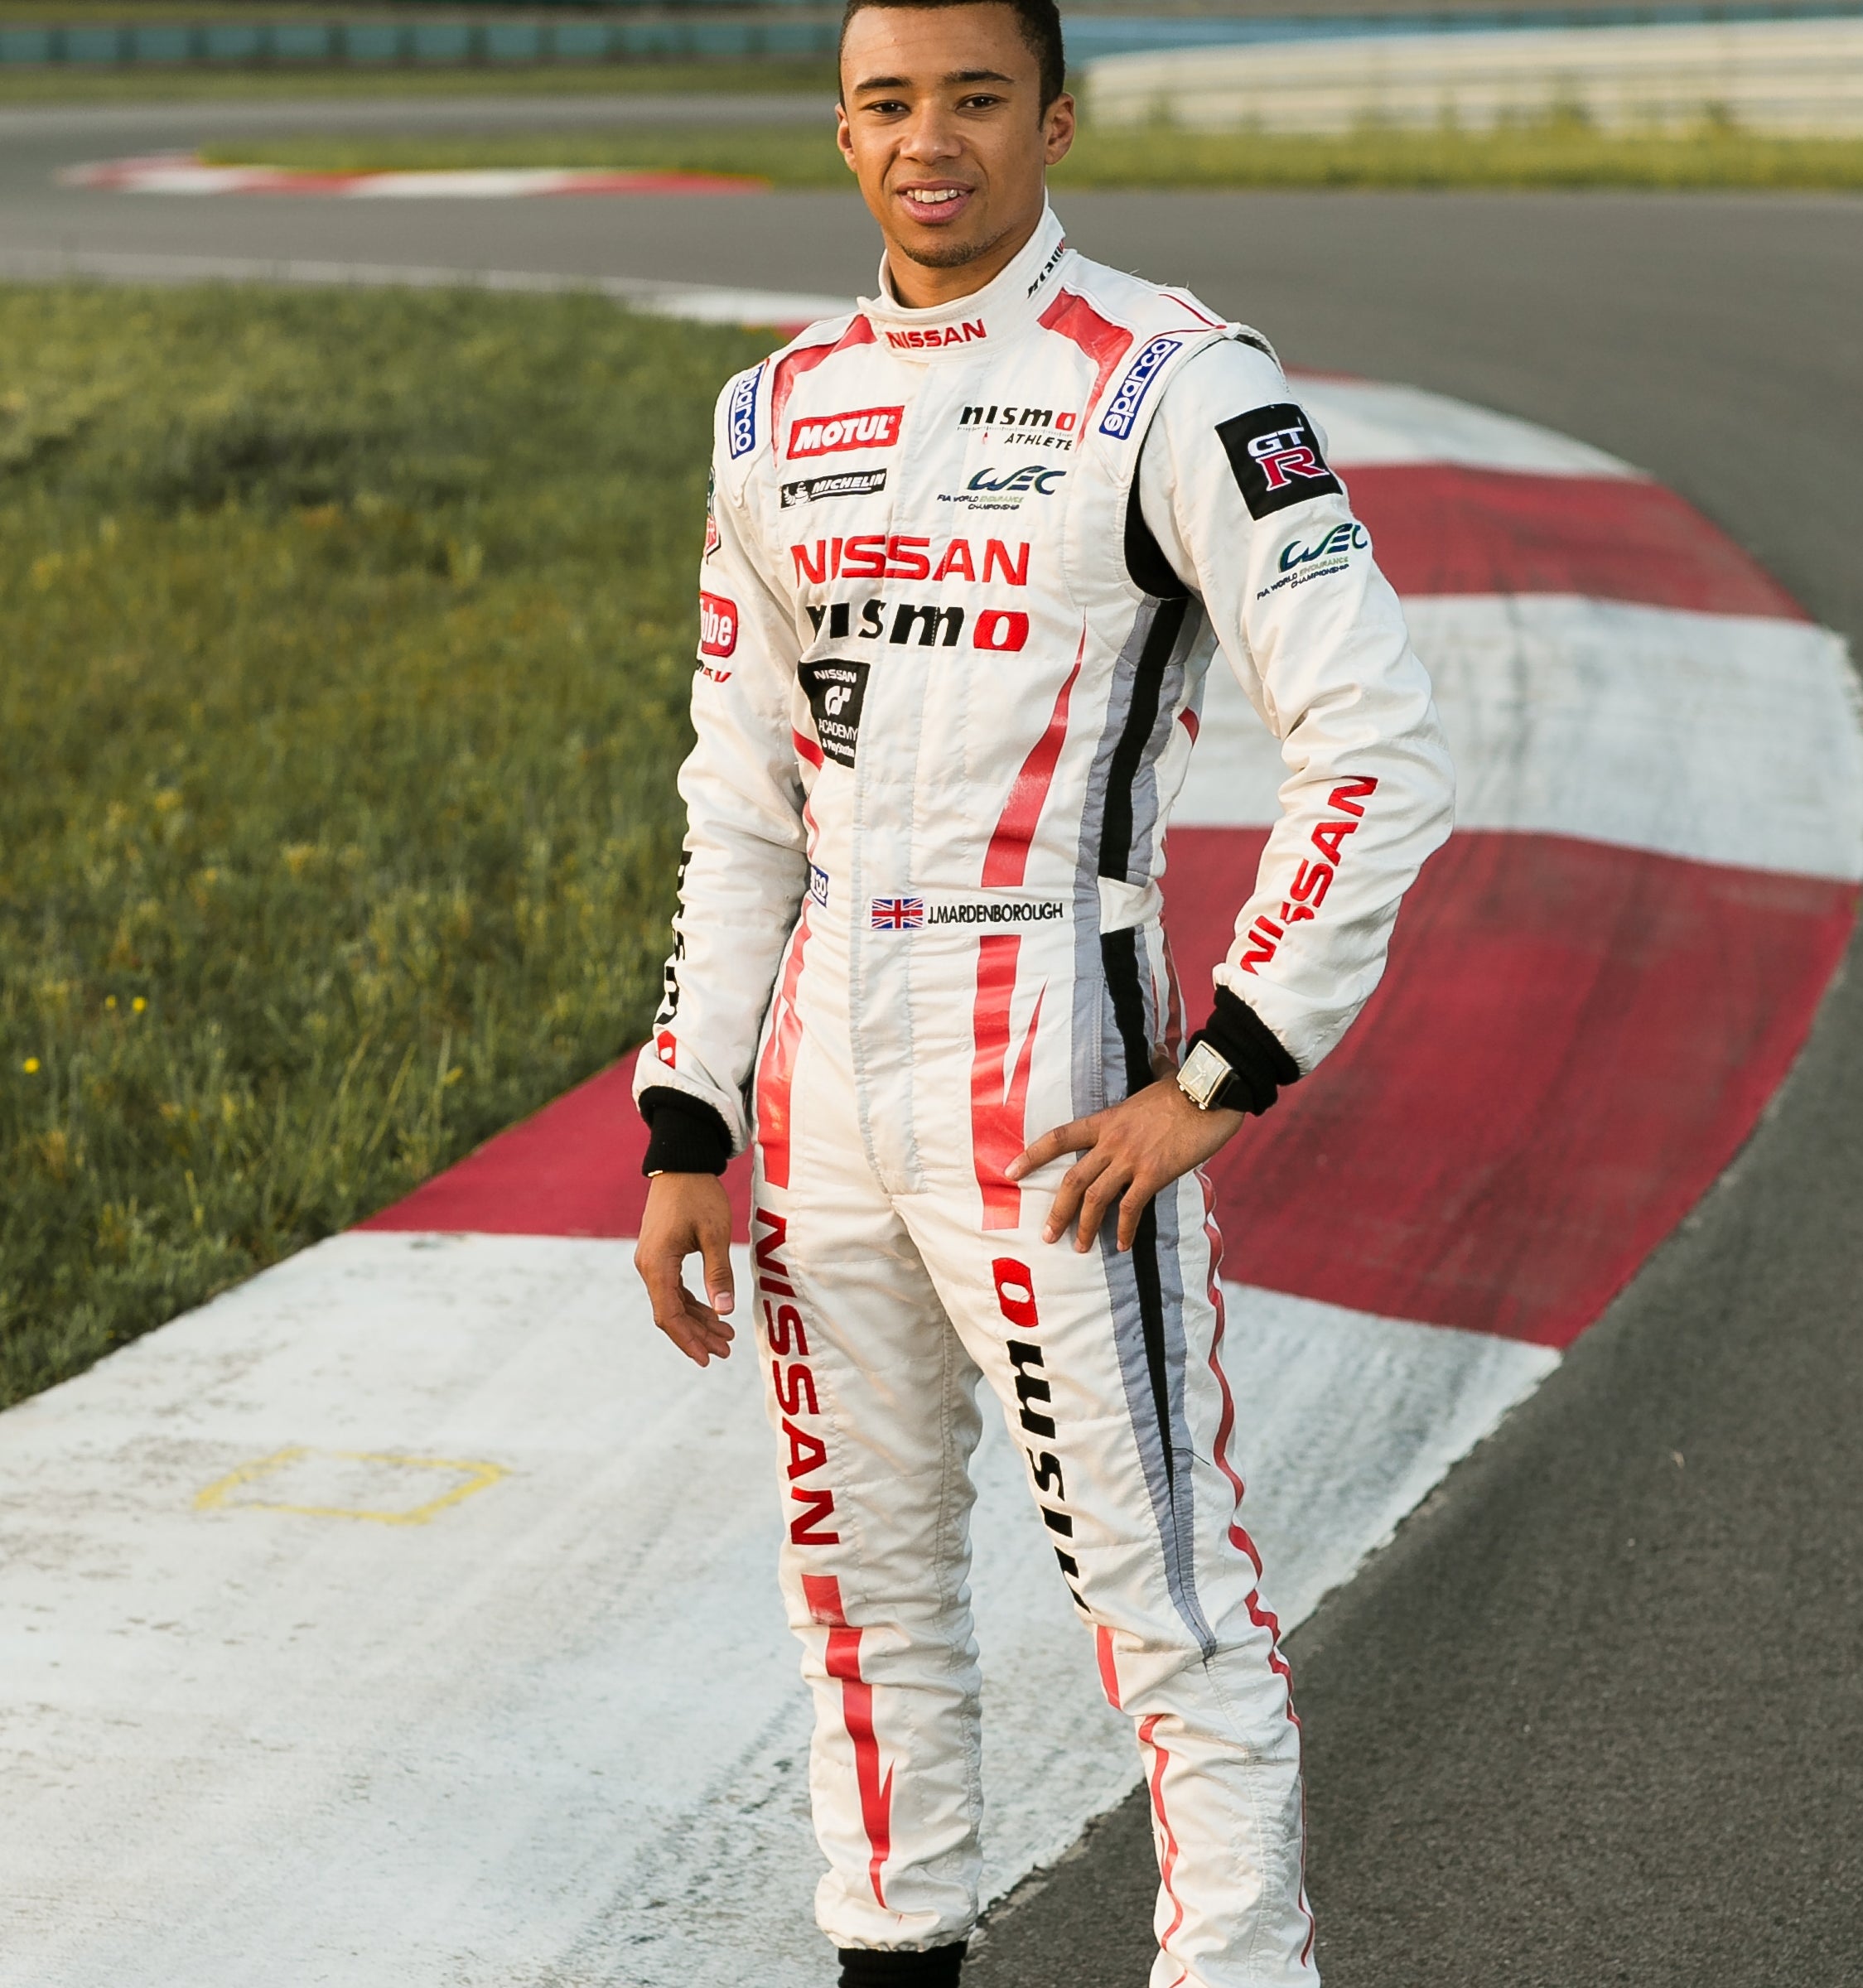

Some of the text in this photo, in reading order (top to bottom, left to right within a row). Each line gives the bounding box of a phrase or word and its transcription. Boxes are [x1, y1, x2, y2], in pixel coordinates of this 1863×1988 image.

[885, 318, 987, 349] NISSAN
[1103, 340, 1175, 434] sparco
[793, 415, 890, 452] MOTUL
[959, 405, 1077, 432] nismo
[1004, 432, 1073, 451] ATHLETE
[1248, 427, 1305, 457] GT
[811, 472, 886, 494] MICHELIN
[967, 465, 1067, 495] WEC
[1255, 446, 1330, 492] R
[937, 494, 1025, 504] FIA WORLD ENDURANCE
[790, 534, 1030, 588] NISSAN
[1278, 523, 1368, 573] WEC
[1257, 555, 1349, 601] FIA WORLD ENDURANCE
[1291, 563, 1349, 589] CHAMPIONSHIP
[805, 599, 1030, 652] nismo
[813, 668, 857, 683] NISSAN
[818, 717, 858, 741] ACADEMY
[1239, 775, 1378, 976] NISSAN
[755, 1207, 840, 1546] NISSAN
